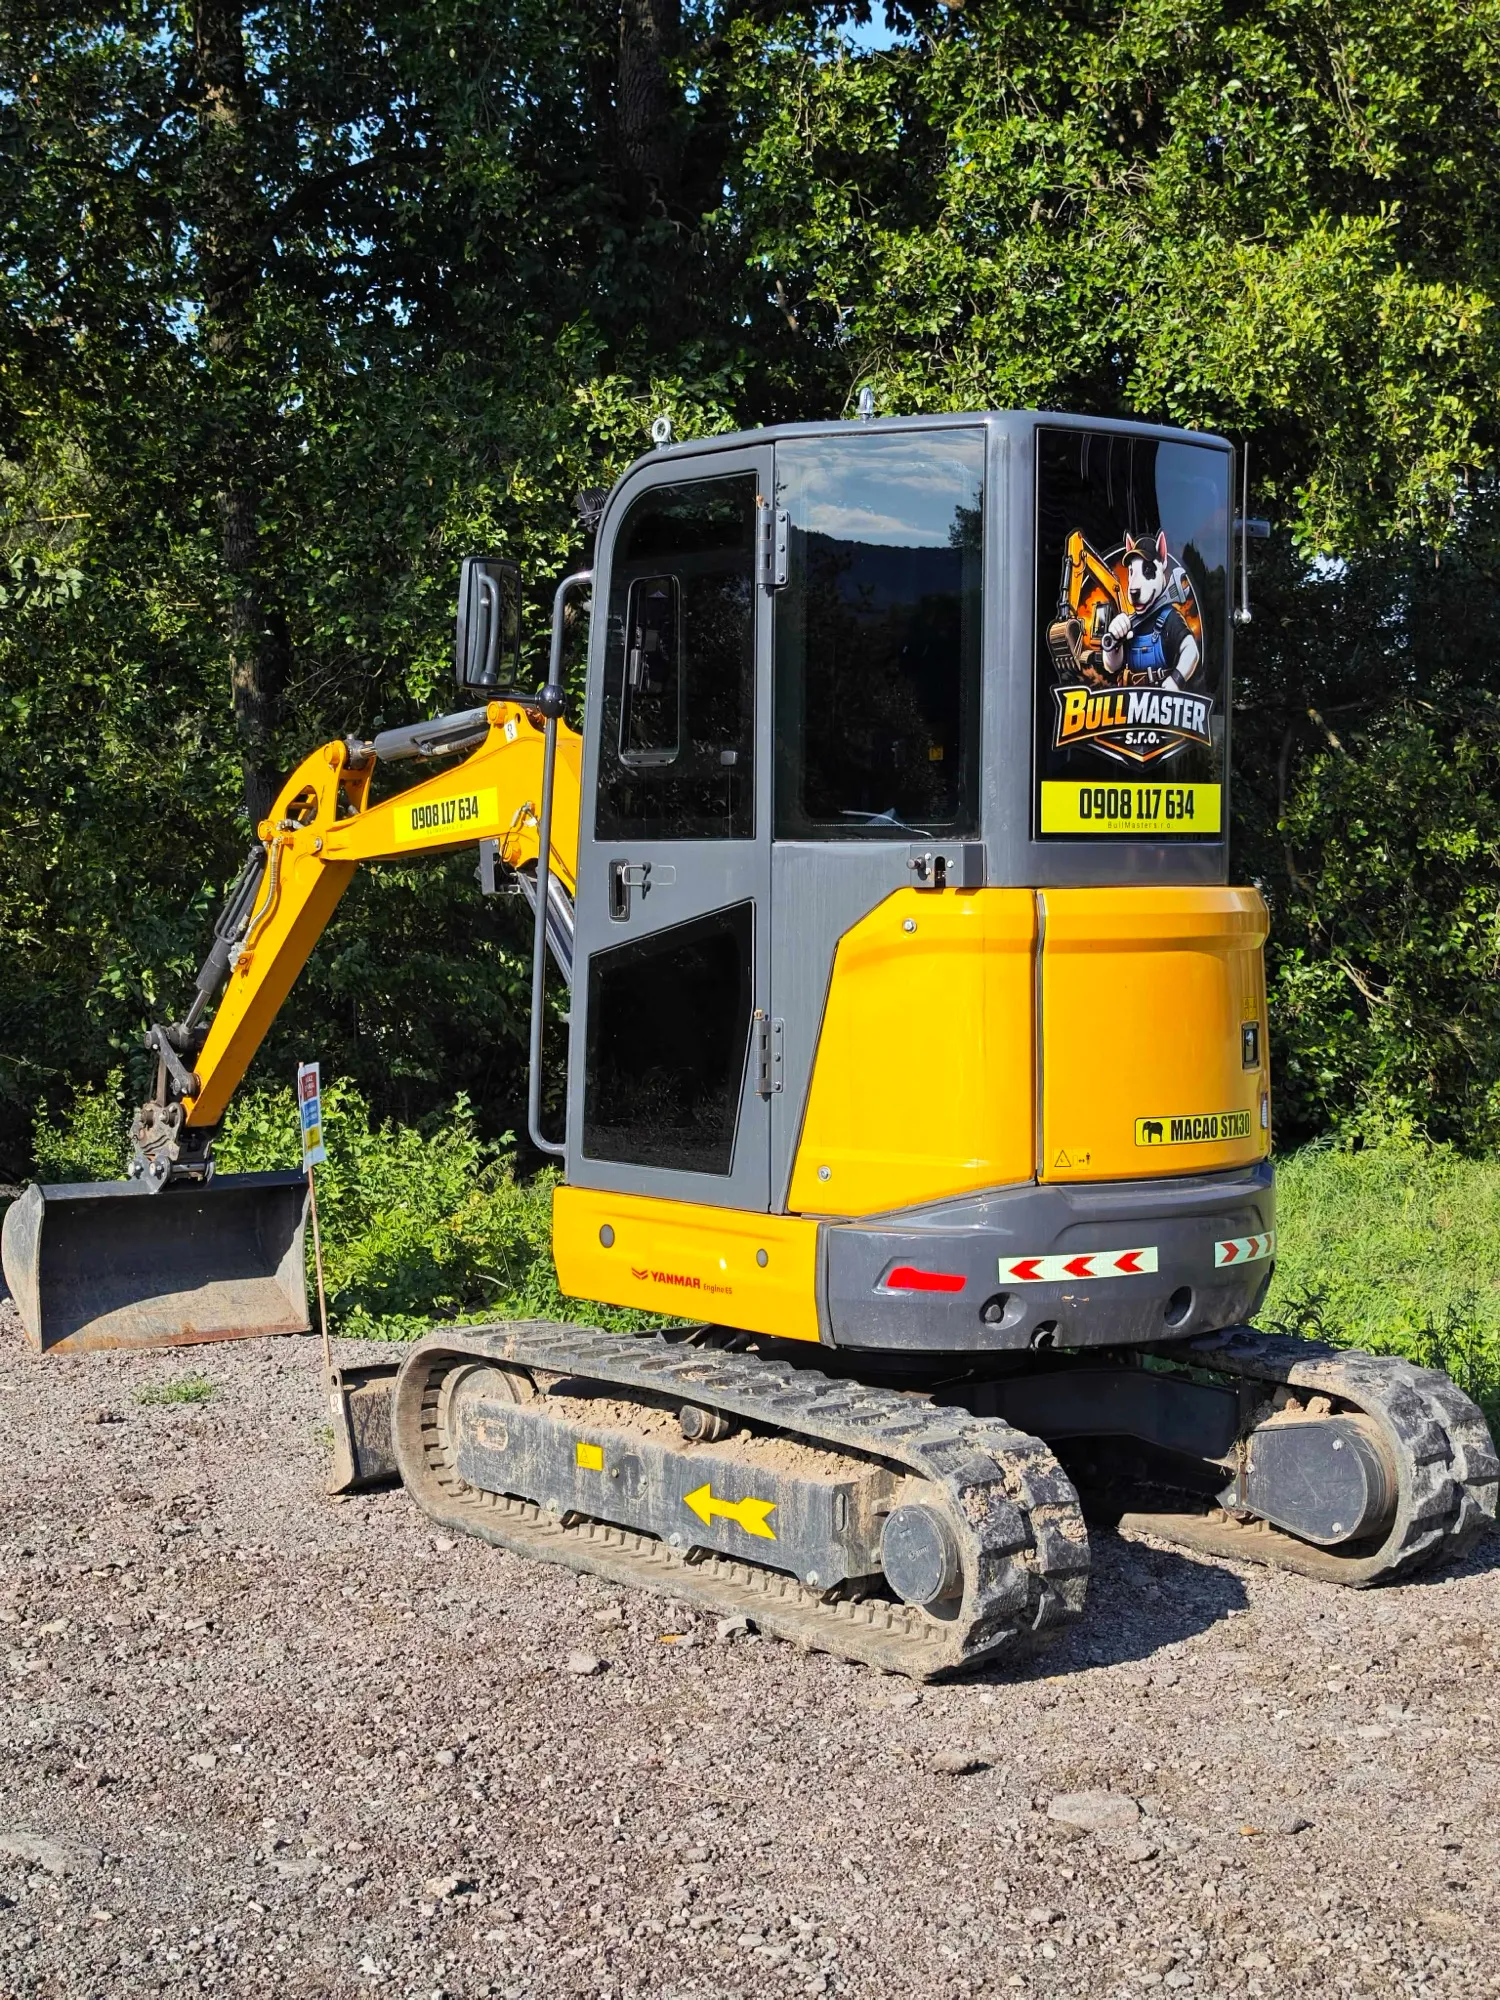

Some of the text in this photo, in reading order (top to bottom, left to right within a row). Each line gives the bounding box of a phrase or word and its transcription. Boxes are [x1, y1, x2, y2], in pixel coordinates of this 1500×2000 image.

[1125, 731, 1160, 745] s.r.o.
[411, 804, 439, 831] 0908
[440, 800, 456, 825] 117
[458, 795, 479, 821] 634
[1079, 788, 1195, 820] 0908 117 634
[1171, 1112, 1250, 1141] MACAO STX30
[651, 1271, 700, 1289] YANMAR
